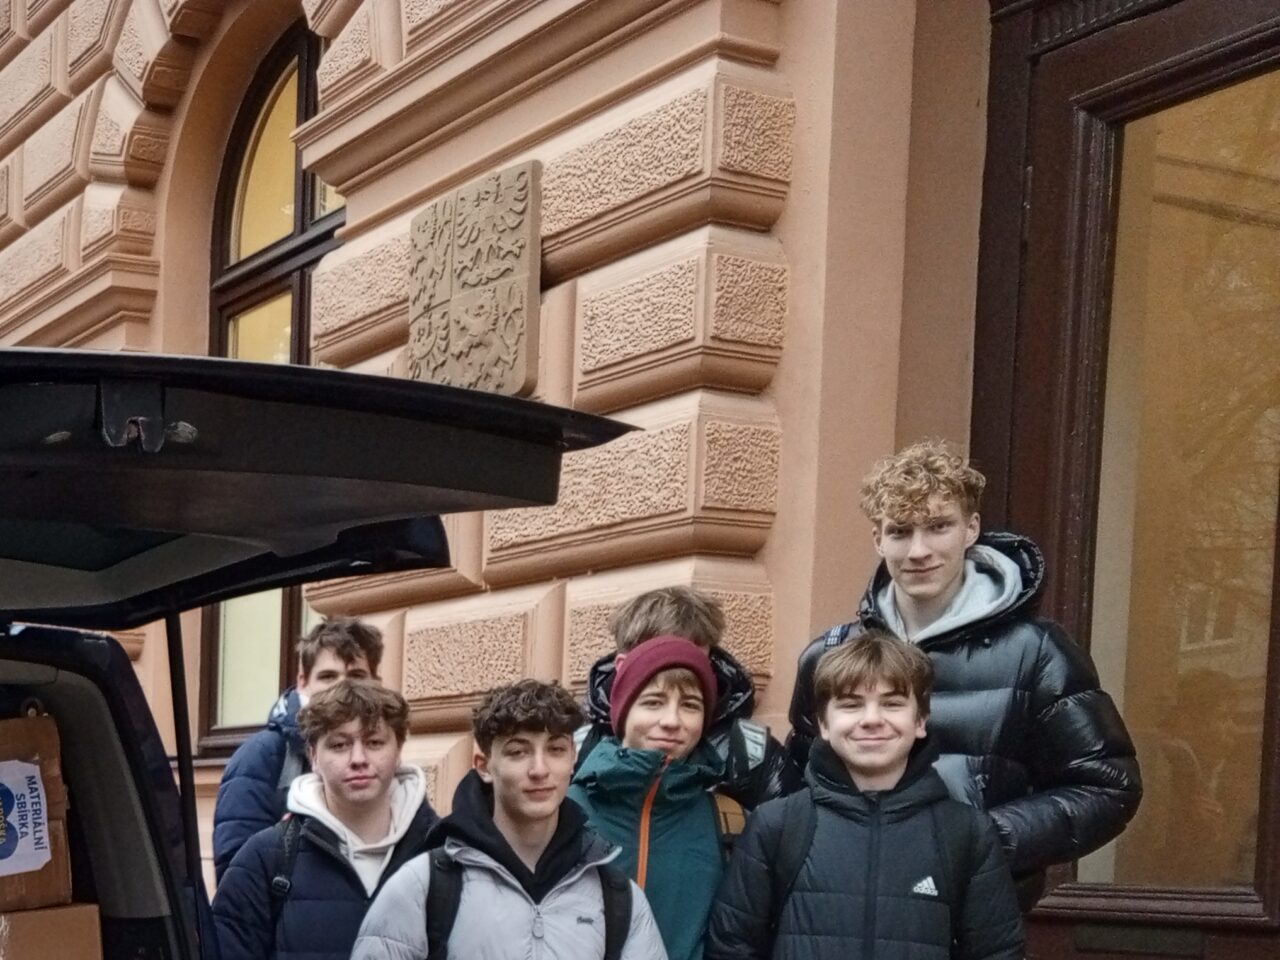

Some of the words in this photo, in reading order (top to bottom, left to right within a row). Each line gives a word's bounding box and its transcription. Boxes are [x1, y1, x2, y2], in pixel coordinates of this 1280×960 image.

[15, 793, 29, 840] SBÍRKA
[25, 775, 48, 851] MATERIÁLNÍ
[913, 886, 938, 897] adidas
